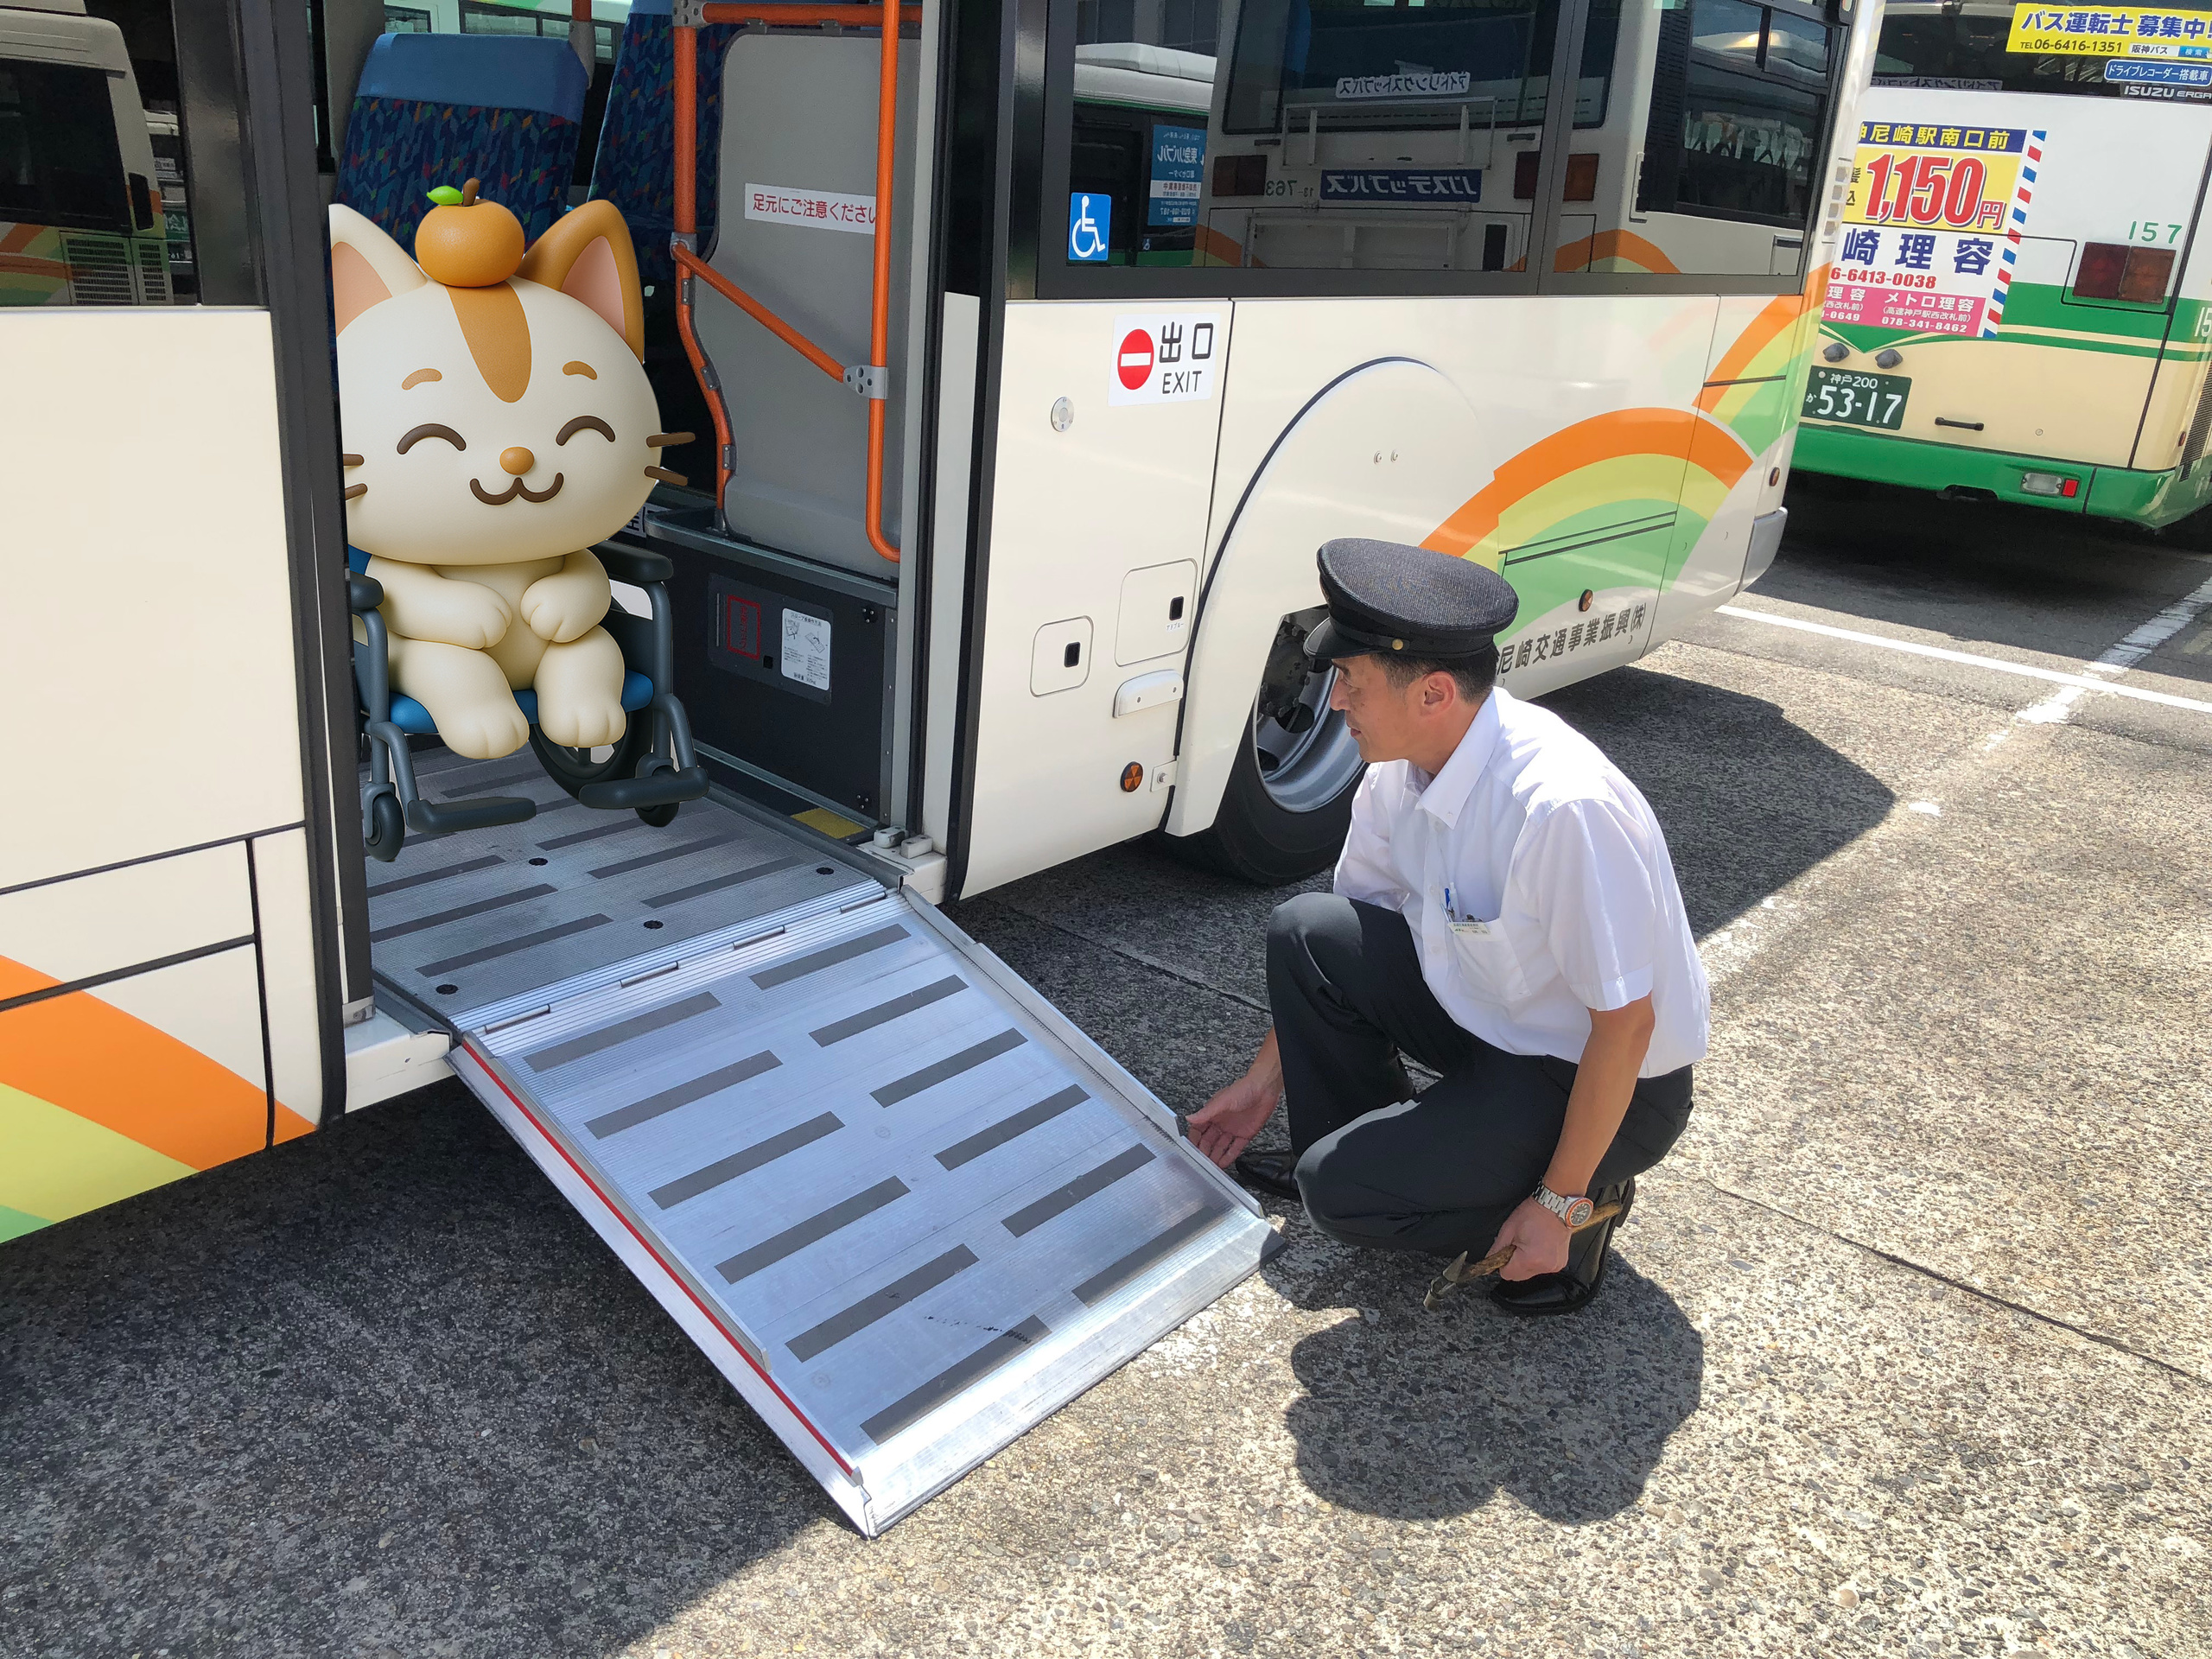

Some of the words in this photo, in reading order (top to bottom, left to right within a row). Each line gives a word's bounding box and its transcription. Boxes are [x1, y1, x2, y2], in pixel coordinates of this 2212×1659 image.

[2021, 10, 2133, 35] バス運転士
[2034, 39, 2122, 53] 06-6416-1351
[2132, 44, 2168, 54] 阪神バス
[2108, 65, 2209, 81] ドライブレコーダー搭載車
[2124, 86, 2175, 98] ISUZU
[1865, 153, 2006, 227] 1,150円
[2128, 221, 2183, 245] 157
[1885, 291, 1975, 311] メトロ理容
[1882, 317, 1967, 334] 078-341-8462
[1159, 321, 1214, 363] 出口
[1162, 371, 1202, 394] EXIT
[1806, 392, 1817, 403] か
[1816, 385, 1903, 424] 53-17
